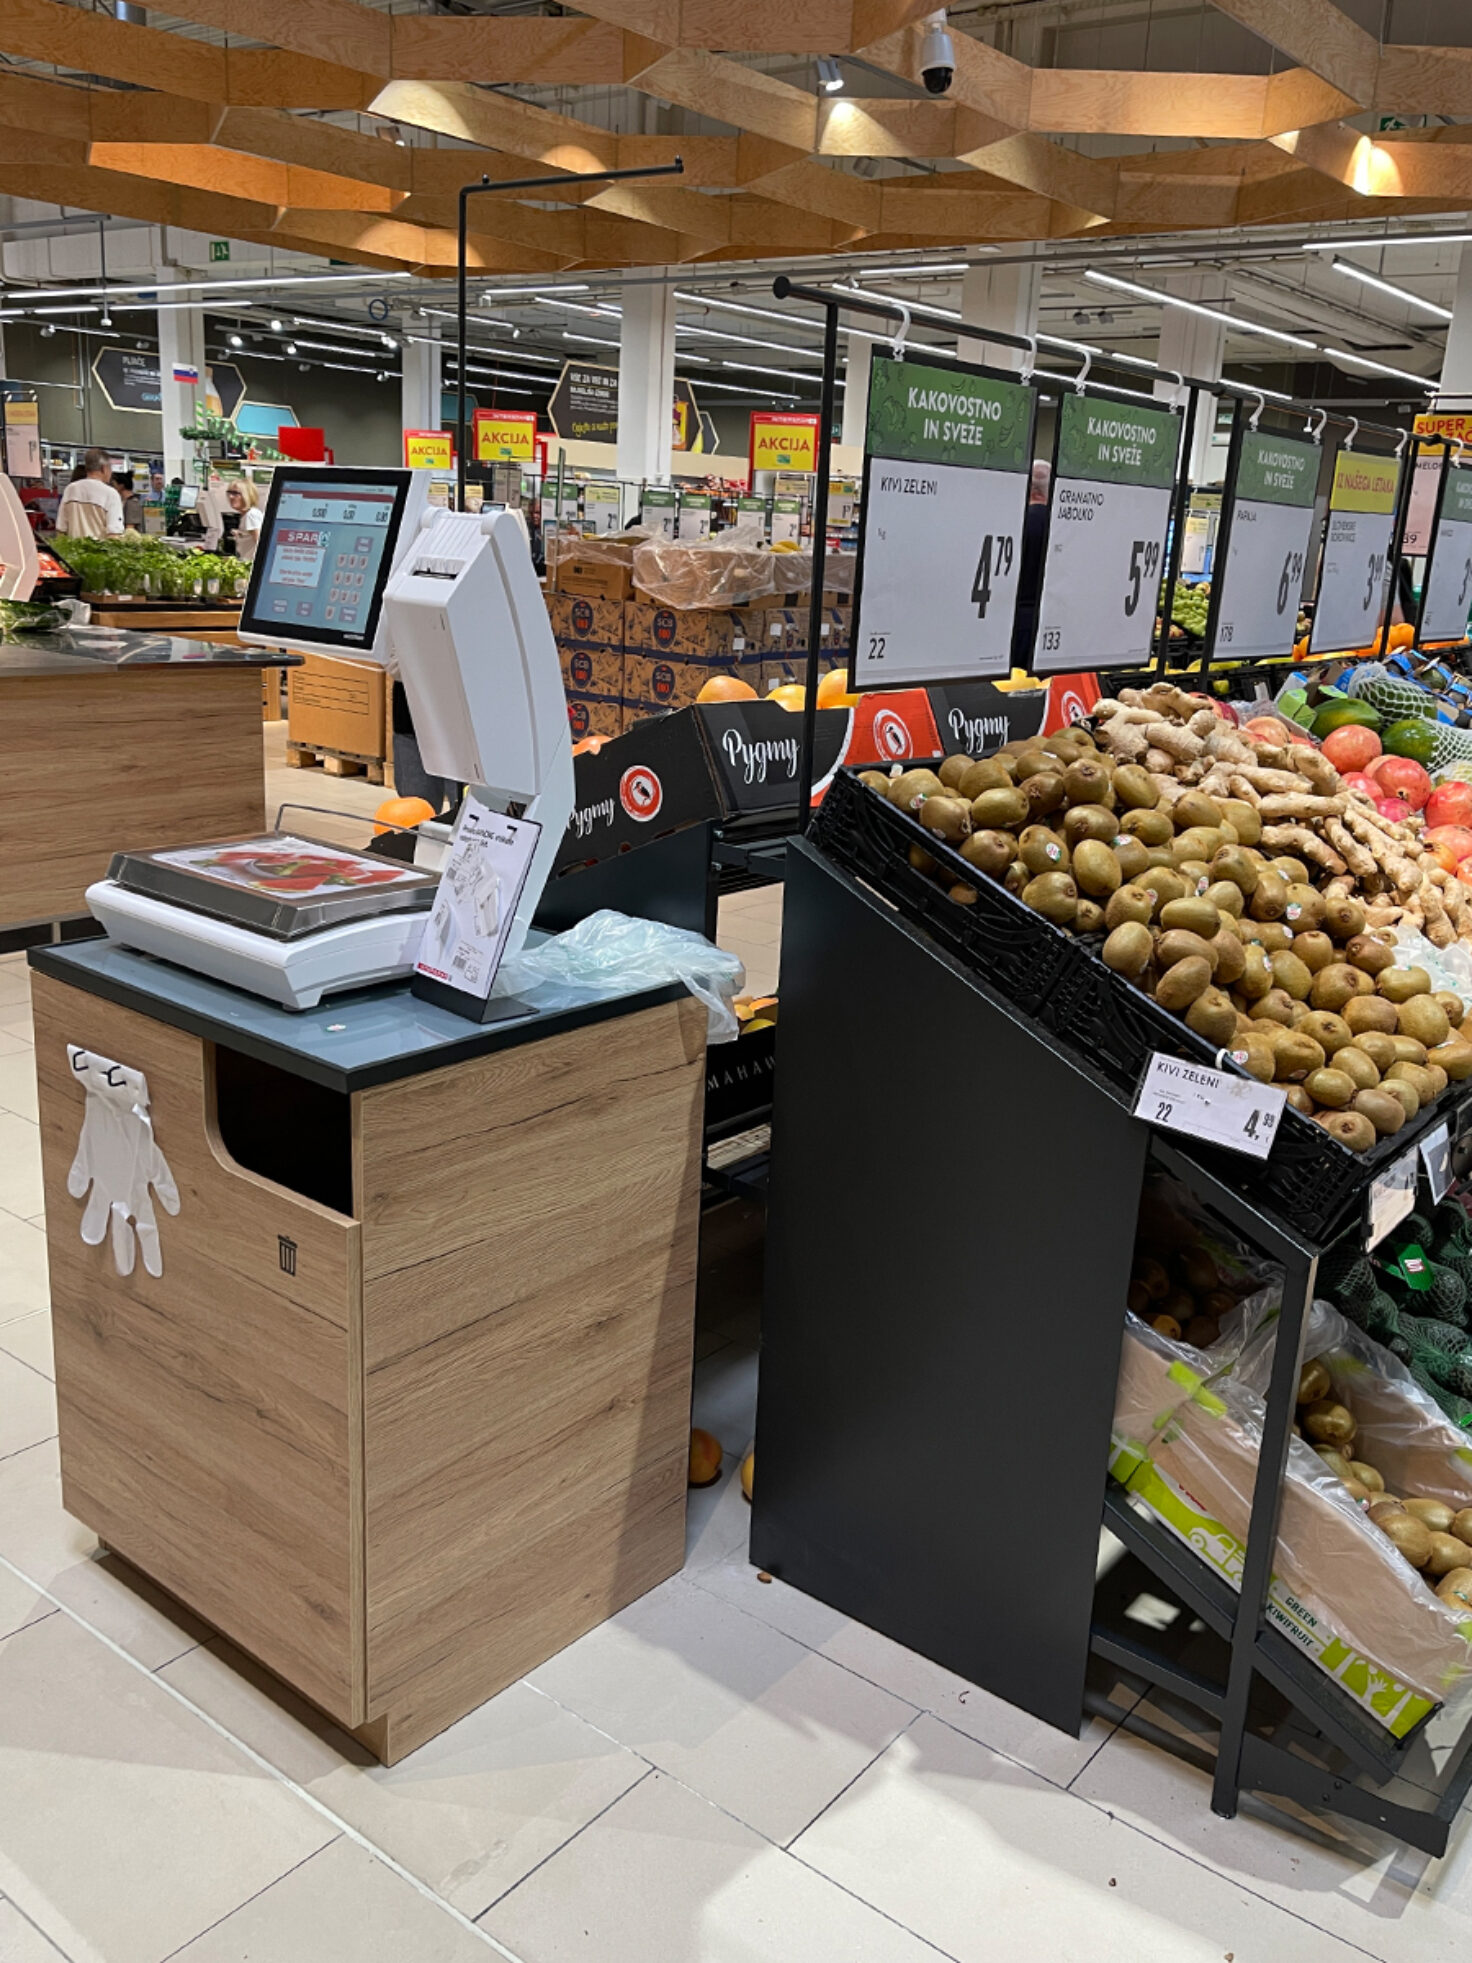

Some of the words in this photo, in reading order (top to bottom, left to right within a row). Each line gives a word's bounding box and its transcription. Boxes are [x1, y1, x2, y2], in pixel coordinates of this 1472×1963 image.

[908, 387, 1001, 421] KAKOVOSTNO
[923, 418, 939, 439] IN
[943, 420, 983, 445] SVEŽE
[1087, 417, 1156, 444] KAKOVOSTNO
[1417, 418, 1466, 434] SUPER
[482, 432, 529, 445] AKCIJA
[759, 437, 810, 451] AKCIJA
[411, 446, 447, 456] AKCIJA
[1098, 443, 1110, 461] IN
[1112, 444, 1142, 466] SVEŽE
[1258, 449, 1305, 471] KAKOVOSTNO
[880, 477, 902, 493] KIVI
[903, 479, 938, 496] ZELENI
[1264, 470, 1274, 486] IN
[1273, 471, 1295, 489] SVEŽE
[1060, 489, 1104, 505] GRANATNO
[1057, 506, 1094, 520] JABOLKO
[287, 532, 320, 544] SPAR
[868, 637, 886, 660] 22
[1043, 631, 1061, 650] 133
[948, 708, 1010, 754] Pygmy
[722, 729, 800, 784] Pygmy
[1156, 1061, 1180, 1077] KIVI
[1182, 1069, 1219, 1088] ZELENI
[1155, 1102, 1173, 1123] 22
[1285, 1597, 1318, 1627] GREEN
[1266, 1602, 1314, 1646] KIWIFRUIT
